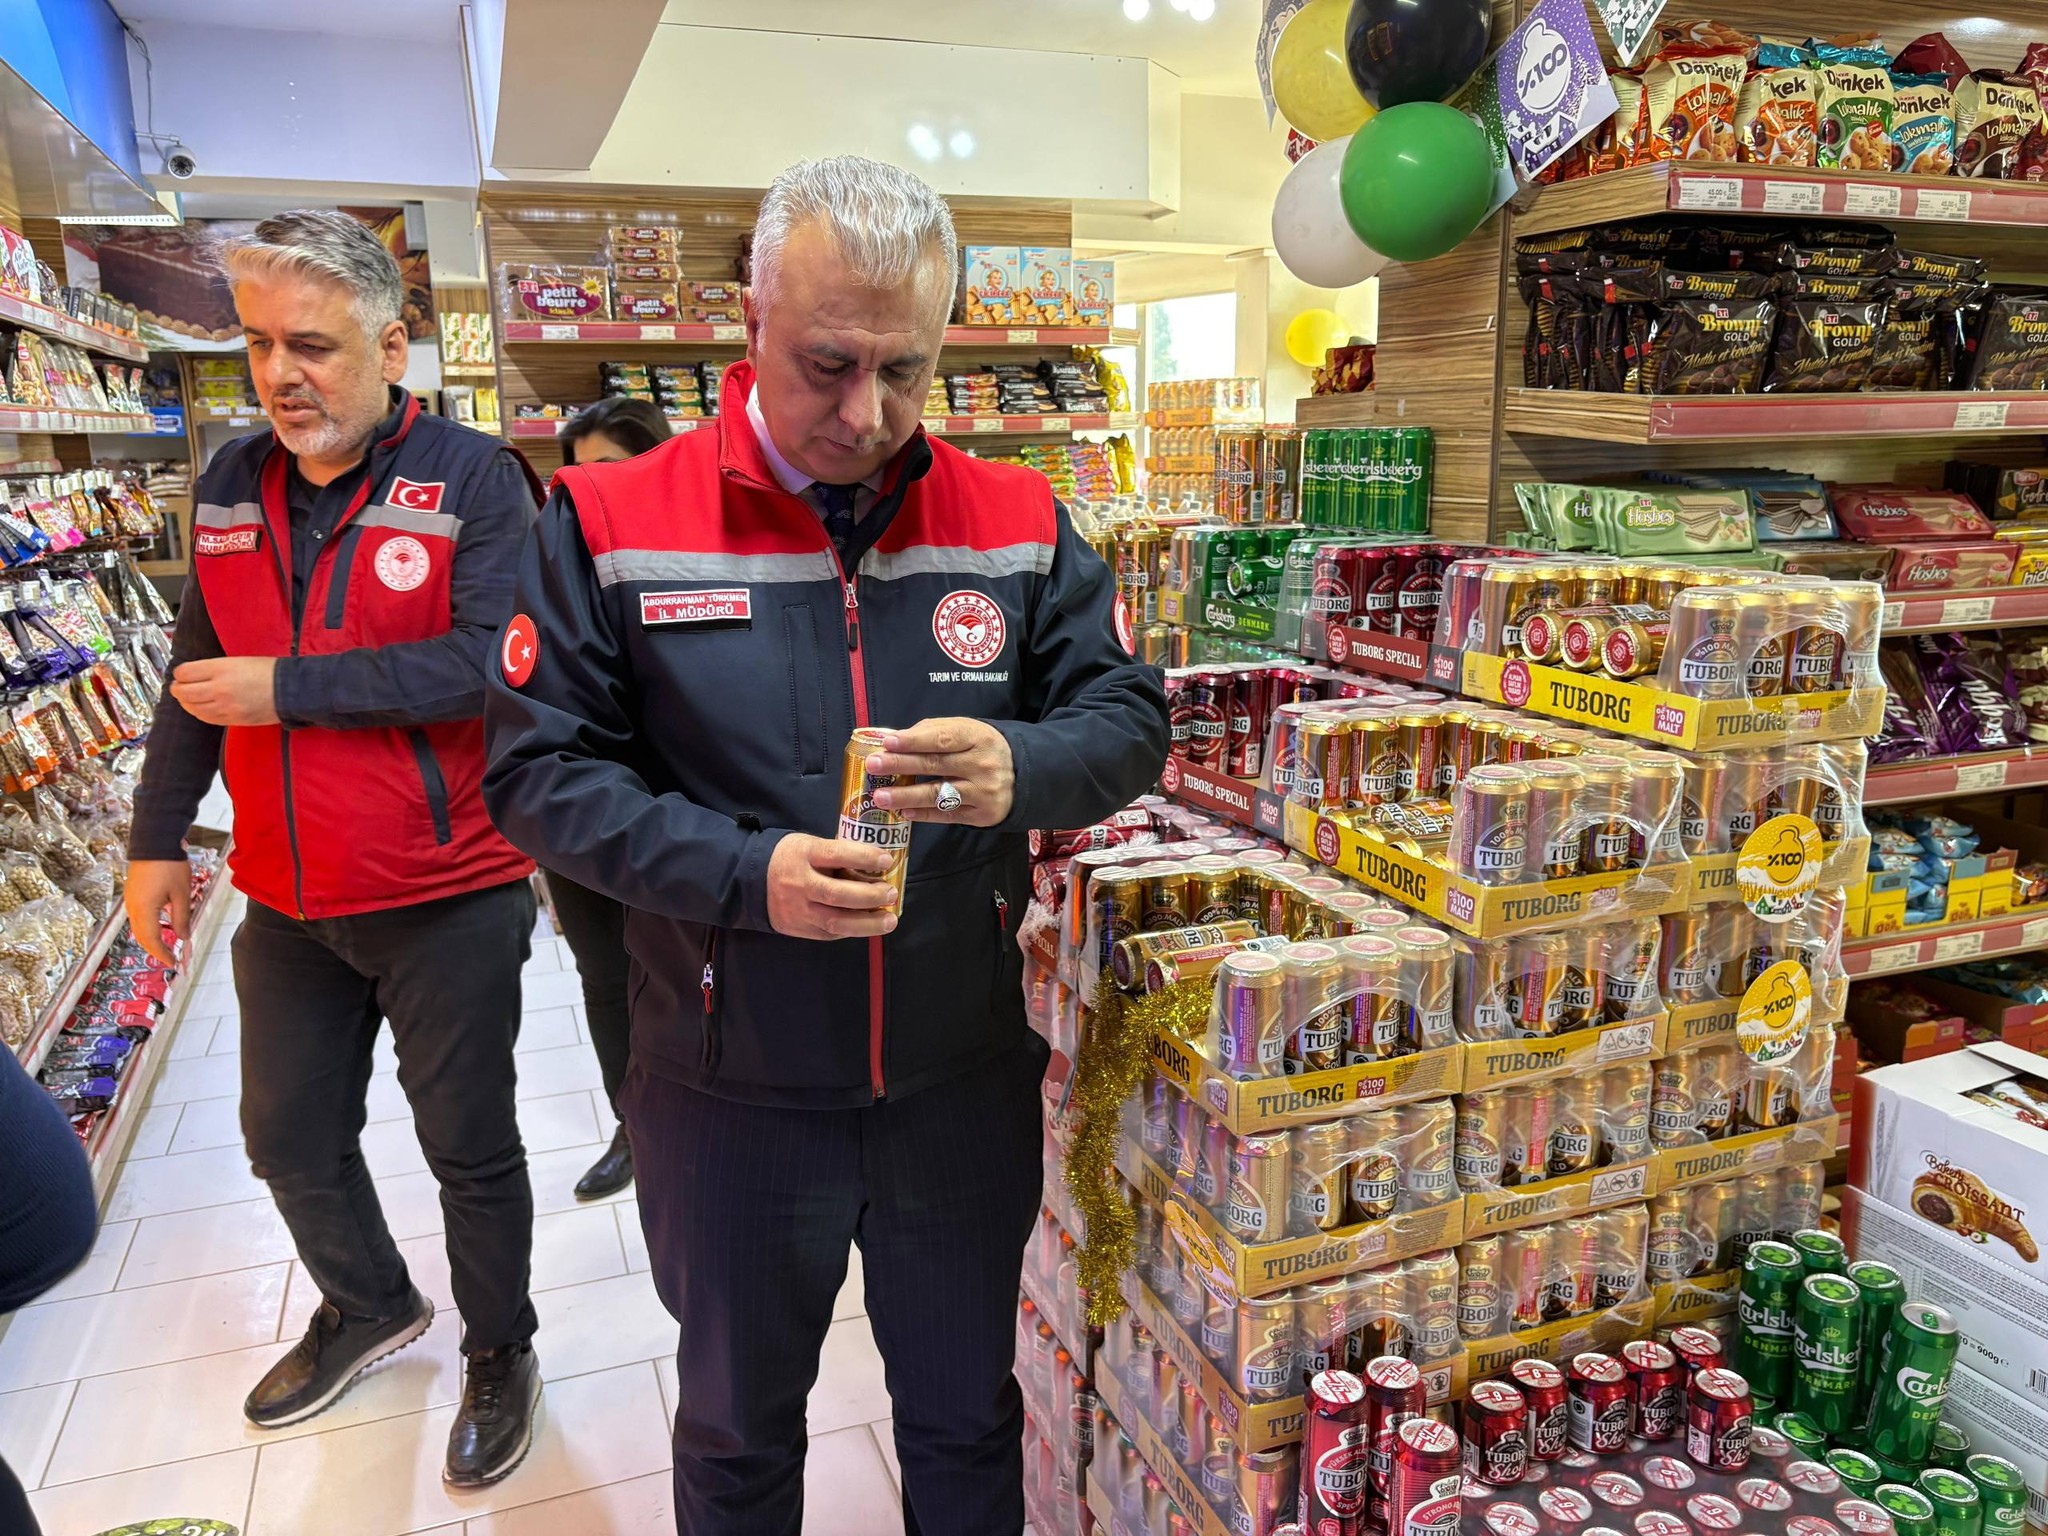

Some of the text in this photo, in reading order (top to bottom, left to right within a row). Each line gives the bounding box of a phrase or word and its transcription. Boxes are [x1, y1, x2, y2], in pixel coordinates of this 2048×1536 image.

[1518, 43, 1568, 99] %100
[1826, 69, 1886, 94] Dankek
[1893, 94, 1951, 115] Dankek
[1985, 87, 2036, 115] Dankek
[1811, 253, 1863, 273] Browni
[1912, 256, 1961, 278] Browni
[543, 286, 578, 300] petit
[1686, 275, 1739, 299] Browni
[1808, 279, 1862, 298] Browni
[537, 295, 587, 309] beurre
[632, 306, 666, 315] beurre
[636, 299, 661, 309] petit
[1697, 313, 1762, 337] Browni
[1808, 319, 1873, 343] Browni
[2008, 314, 2048, 334] Brow
[1723, 332, 1751, 342] GOLD
[1832, 337, 1861, 347] GOLD
[1898, 332, 1922, 342] GOLD
[658, 603, 735, 620] İL MÜDÜRÜ
[1238, 617, 1270, 632] DENMARK
[1351, 641, 1384, 661] TUBORG
[1386, 650, 1422, 669] SPECIAL
[928, 671, 950, 682] TARIM
[950, 671, 961, 682] VE
[961, 671, 984, 682] ORMAN
[1684, 661, 1737, 680] TUBOR
[1752, 659, 1782, 675] ORG
[1550, 681, 1631, 723] TUBORG
[1193, 723, 1223, 736] BORG
[1657, 720, 1681, 735] MALT
[1717, 712, 1786, 737] TUBORG
[1183, 774, 1250, 811] TUBORG SPECIAL
[1261, 812, 1278, 824] MALT
[841, 820, 910, 846] TUBORG
[1601, 838, 1628, 854] TUB
[1479, 849, 1526, 866] TUBO
[1767, 852, 1802, 867] %100
[1356, 845, 1427, 903] TUBORG
[1699, 868, 1737, 890] TUB
[1450, 904, 1471, 922] MALT
[1503, 891, 1582, 922] TUBORG
[1673, 970, 1702, 987] TUB
[1763, 994, 1794, 1016] %100
[1304, 1029, 1341, 1048] TUBO
[1154, 1035, 1191, 1083] BORG
[1486, 1047, 1566, 1076] TUBORG
[1257, 1082, 1345, 1118] TUBORG
[1359, 1086, 1382, 1097] MALT
[1554, 1136, 1588, 1152] ORG
[1455, 1156, 1499, 1173] BORG
[1675, 1149, 1745, 1180] TUBORG
[1924, 1153, 1965, 1185] Bakery
[1356, 1180, 1399, 1198] TUBO
[1932, 1172, 2026, 1226] CROISSANT
[1263, 1243, 1349, 1281] TUBORG
[1477, 1338, 1550, 1373] TUBORG
[1976, 1344, 2000, 1365] 900g
[1717, 1437, 1751, 1451] TUBO
[1485, 1449, 1527, 1463] TUBOR
[1319, 1469, 1368, 1488] TUBO
